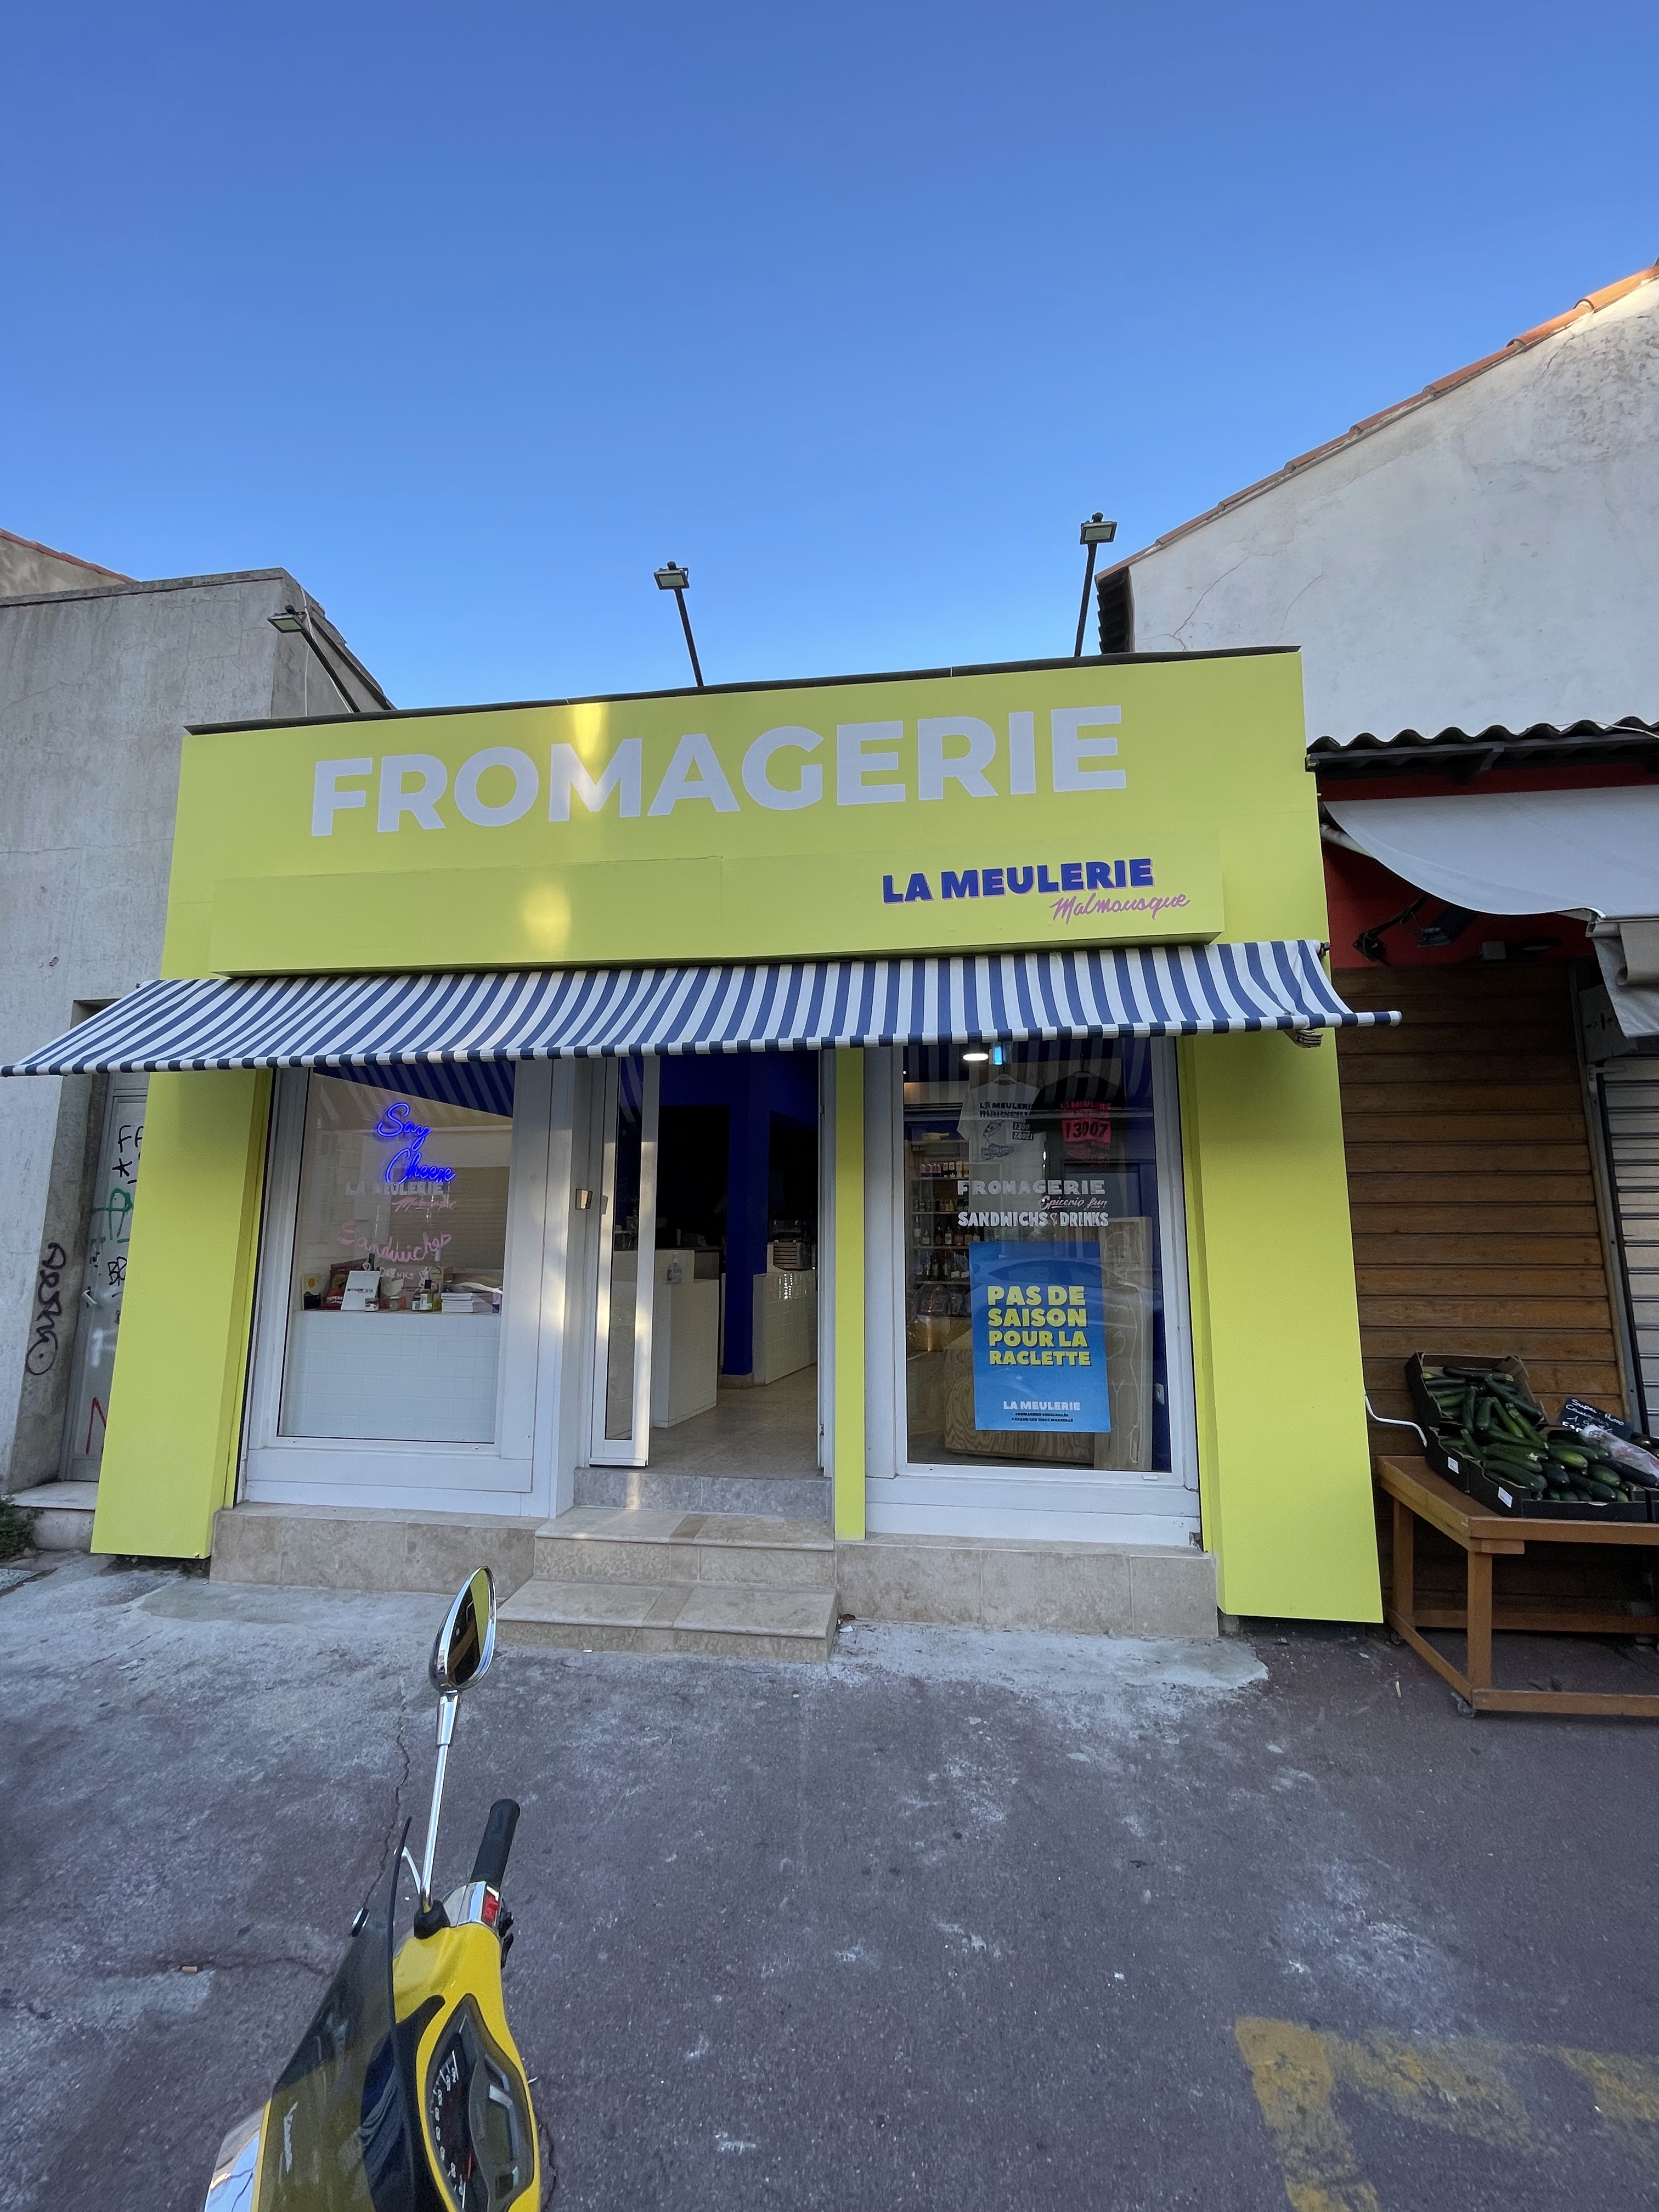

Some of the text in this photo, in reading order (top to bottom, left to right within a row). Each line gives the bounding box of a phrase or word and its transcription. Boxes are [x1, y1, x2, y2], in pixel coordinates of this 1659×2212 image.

[311, 705, 1127, 837] FROMAGERIE
[883, 858, 1155, 904] LA MEULERIE
[1049, 893, 1191, 925] Malmousque
[992, 1102, 1032, 1110] MEULERI
[377, 1102, 432, 1152] Say
[1065, 1122, 1109, 1139] 13007
[386, 1148, 457, 1185] Cheese
[957, 1180, 1105, 1195] FROMAGERIE
[958, 1211, 1048, 1227] SANDWICHS
[1059, 1211, 1109, 1227] DRINKS
[988, 1285, 1086, 1306] PAS DE
[988, 1308, 1087, 1327] SAISON
[989, 1330, 1088, 1347] POUR LA
[989, 1350, 1091, 1365] RACLETTE
[1003, 1401, 1081, 1411] LA MEULERIE
